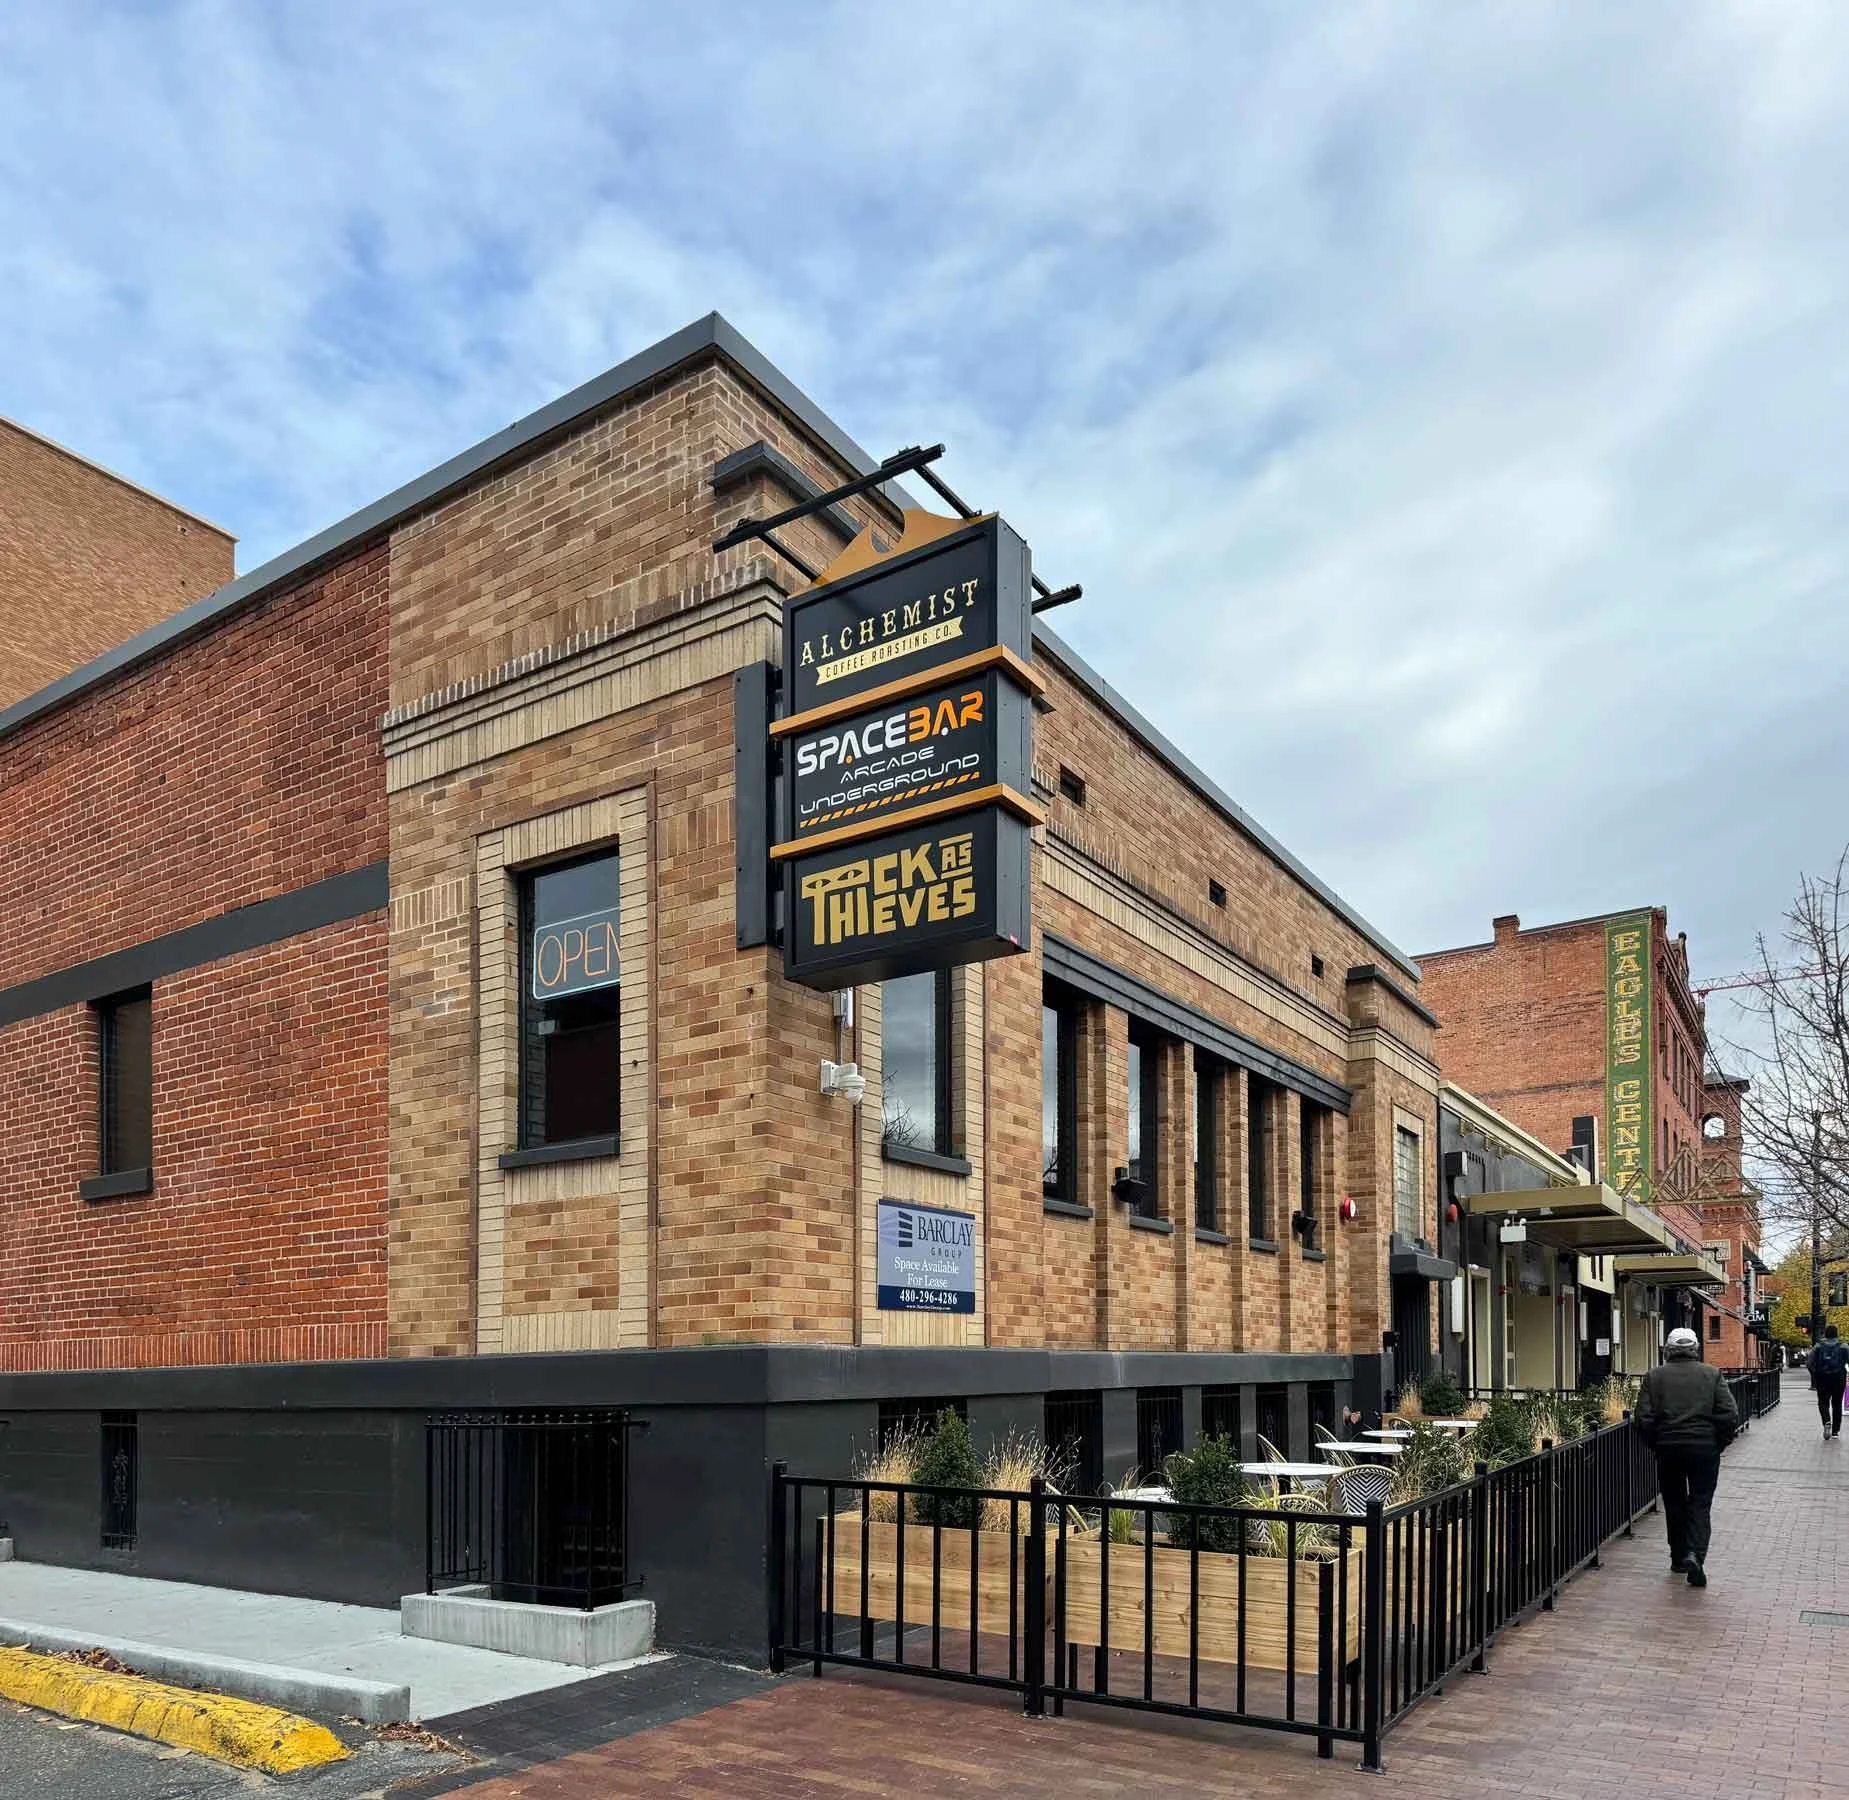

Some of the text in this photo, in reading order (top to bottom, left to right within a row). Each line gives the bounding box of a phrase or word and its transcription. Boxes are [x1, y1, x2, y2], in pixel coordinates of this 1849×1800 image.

[800, 578, 978, 667] ALCHEMIST
[825, 624, 952, 679] COFFEE ROASTING CO.
[797, 690, 983, 777] SPACEBAR
[800, 753, 980, 814] UNDERGROUND
[840, 745, 935, 784] ARCADE
[801, 841, 972, 945] THICK AS
[801, 866, 976, 945] THIEVES
[538, 921, 621, 987] OPEN
[1614, 931, 1642, 1202] EAGLES CENTE
[917, 1216, 974, 1246] BARCLAY
[894, 1256, 960, 1273] Space Available
[907, 1273, 949, 1288] For Lease
[900, 1289, 957, 1304] 480-296-4286
